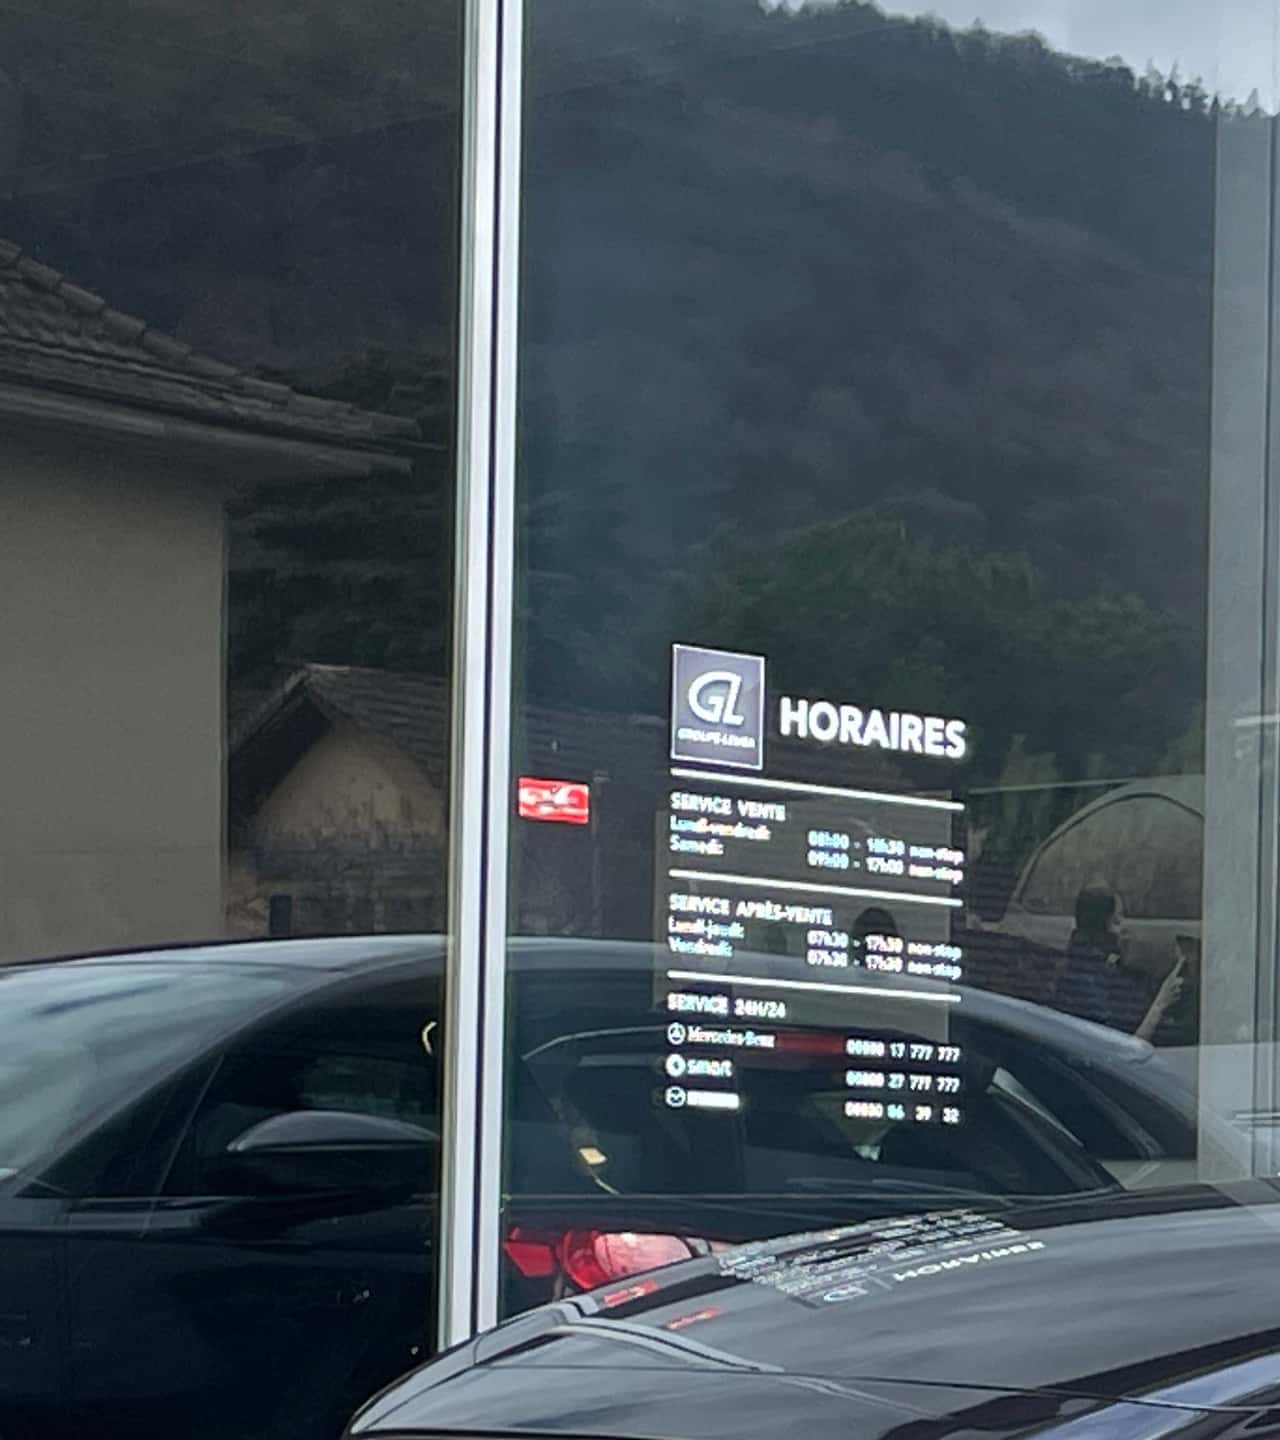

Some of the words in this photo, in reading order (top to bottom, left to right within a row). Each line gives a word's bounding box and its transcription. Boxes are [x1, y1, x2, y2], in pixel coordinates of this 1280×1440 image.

[780, 697, 966, 758] HORAIRES
[670, 792, 732, 815] SERVICE
[737, 800, 786, 821] VENTE
[670, 893, 730, 915] SERVICE
[667, 992, 728, 1016] SERVICE
